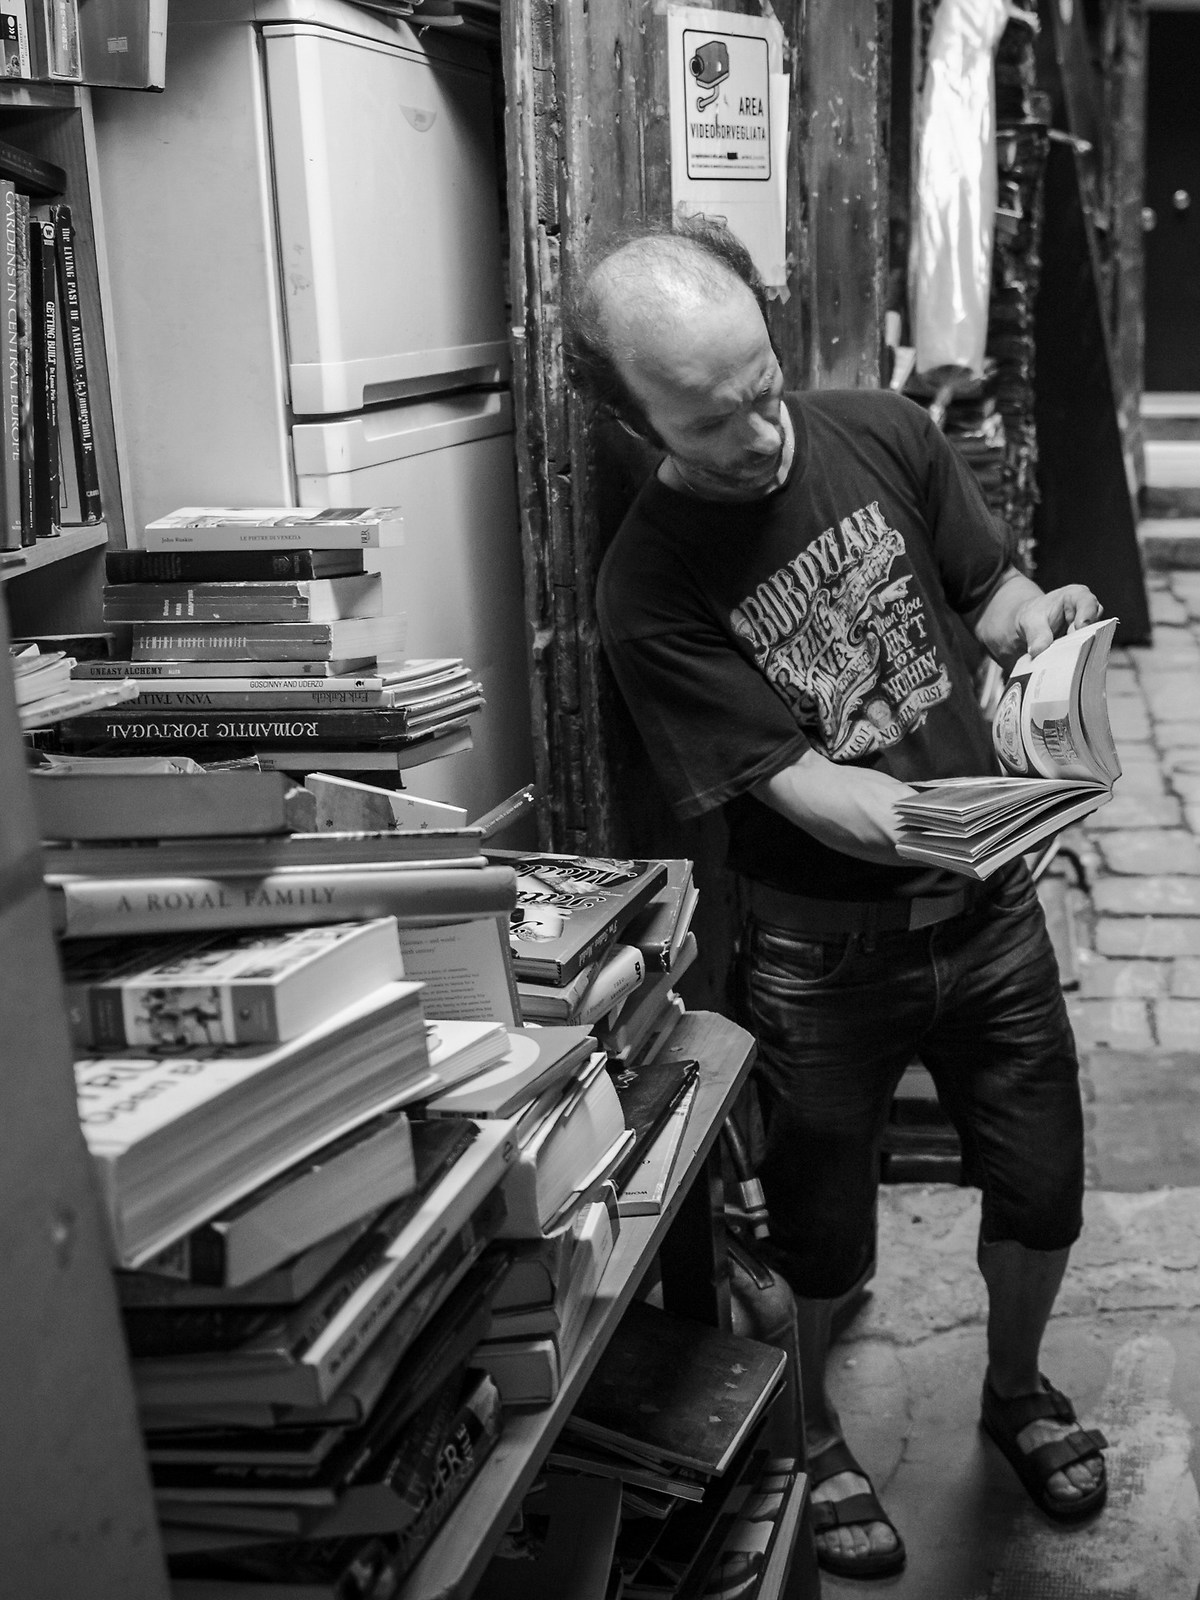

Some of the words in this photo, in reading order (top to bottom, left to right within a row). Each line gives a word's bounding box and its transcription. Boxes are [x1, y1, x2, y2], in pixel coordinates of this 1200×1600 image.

[738, 97, 764, 117] AREA
[5, 190, 17, 277] GARDENS
[63, 246, 75, 278] LIVING
[7, 282, 17, 303] IN
[67, 281, 78, 307] PAST
[45, 301, 56, 339] GETTING
[70, 310, 80, 321] OF
[7, 307, 19, 390] CENTRAL
[47, 339, 57, 365] BUILT
[738, 568, 811, 647] BOB
[89, 666, 123, 676] UNEASY
[124, 666, 163, 676] ALCHEMY
[249, 680, 284, 690] GOSCINNY
[284, 680, 298, 689] AND
[298, 680, 324, 689] UDERZO
[176, 693, 212, 704] VANA
[106, 722, 210, 739] PORTUGAL
[216, 722, 319, 737] ROMANTIC
[115, 894, 133, 913] A
[146, 890, 231, 911] ROYAL
[243, 886, 338, 906] FAMILY
